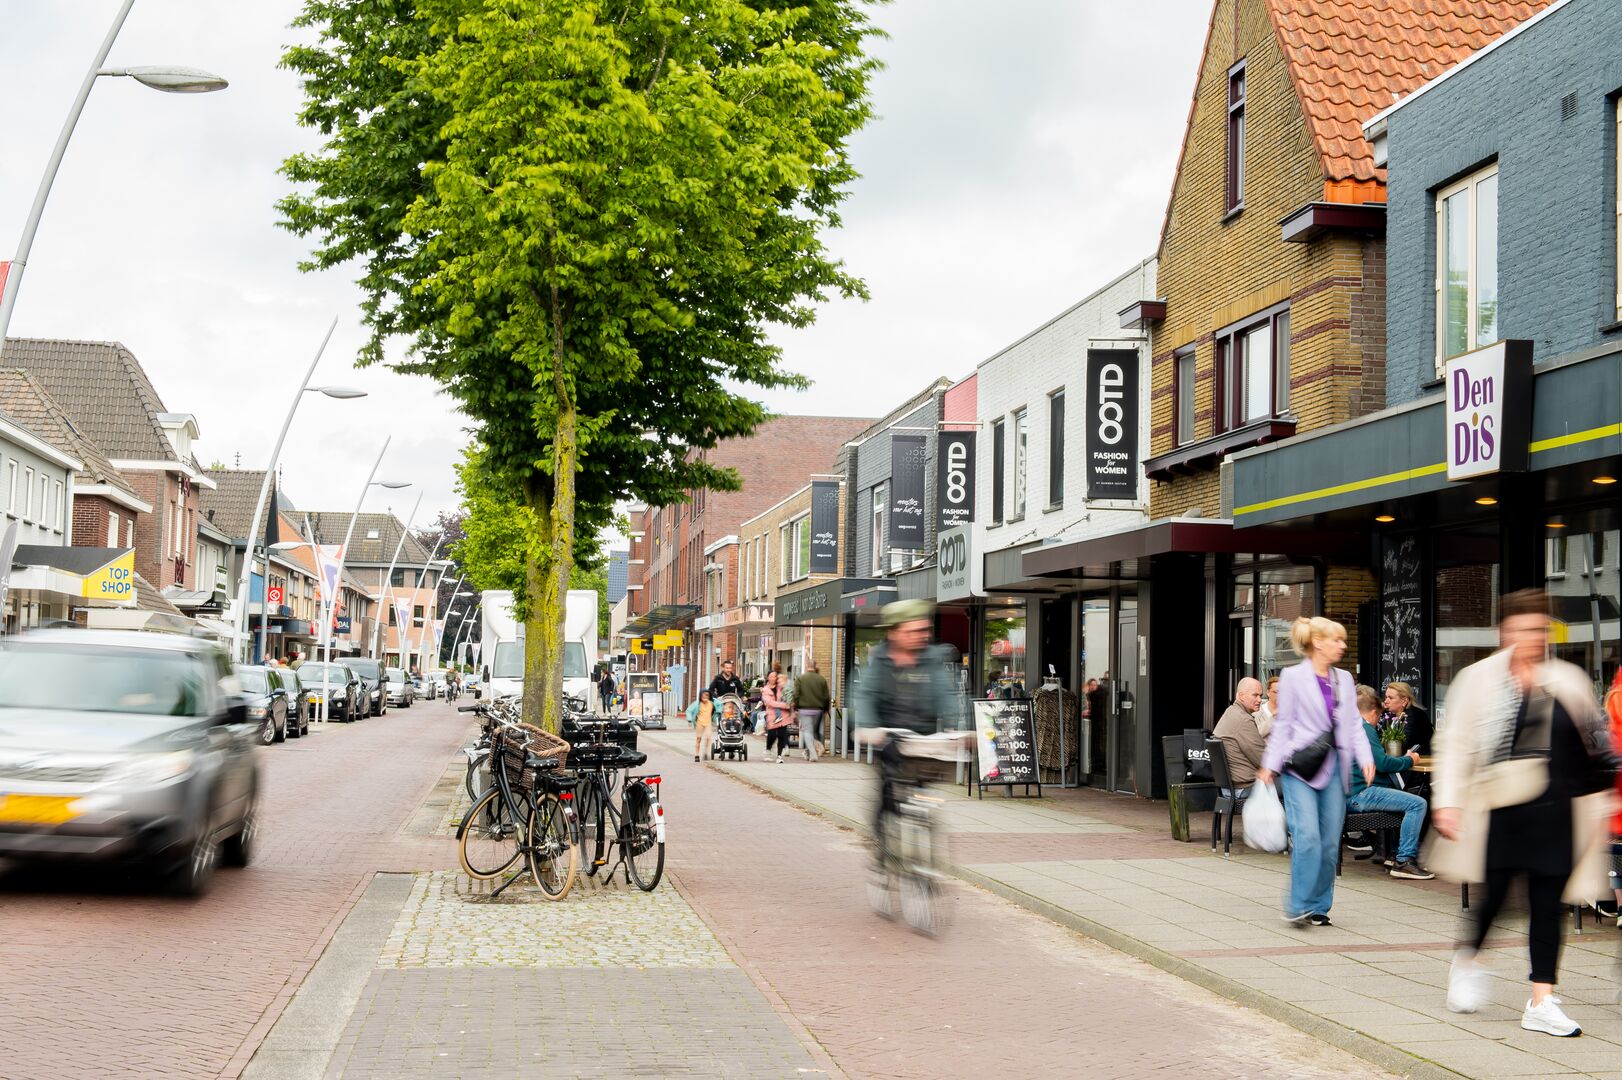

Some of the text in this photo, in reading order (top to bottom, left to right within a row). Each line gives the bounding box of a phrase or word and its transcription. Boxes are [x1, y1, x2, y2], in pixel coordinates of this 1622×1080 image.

[1454, 368, 1494, 412] Den
[1099, 363, 1124, 445] OOTD
[1093, 452, 1128, 460] FASHION
[1095, 466, 1127, 474] WOMEN
[1106, 460, 1116, 469] for
[947, 441, 967, 504] OOTD
[943, 508, 969, 516] FASHION
[940, 533, 966, 577] OOTD
[109, 568, 129, 579] TOP
[102, 581, 131, 593] SHOP
[1004, 704, 1029, 712] ACTIE!
